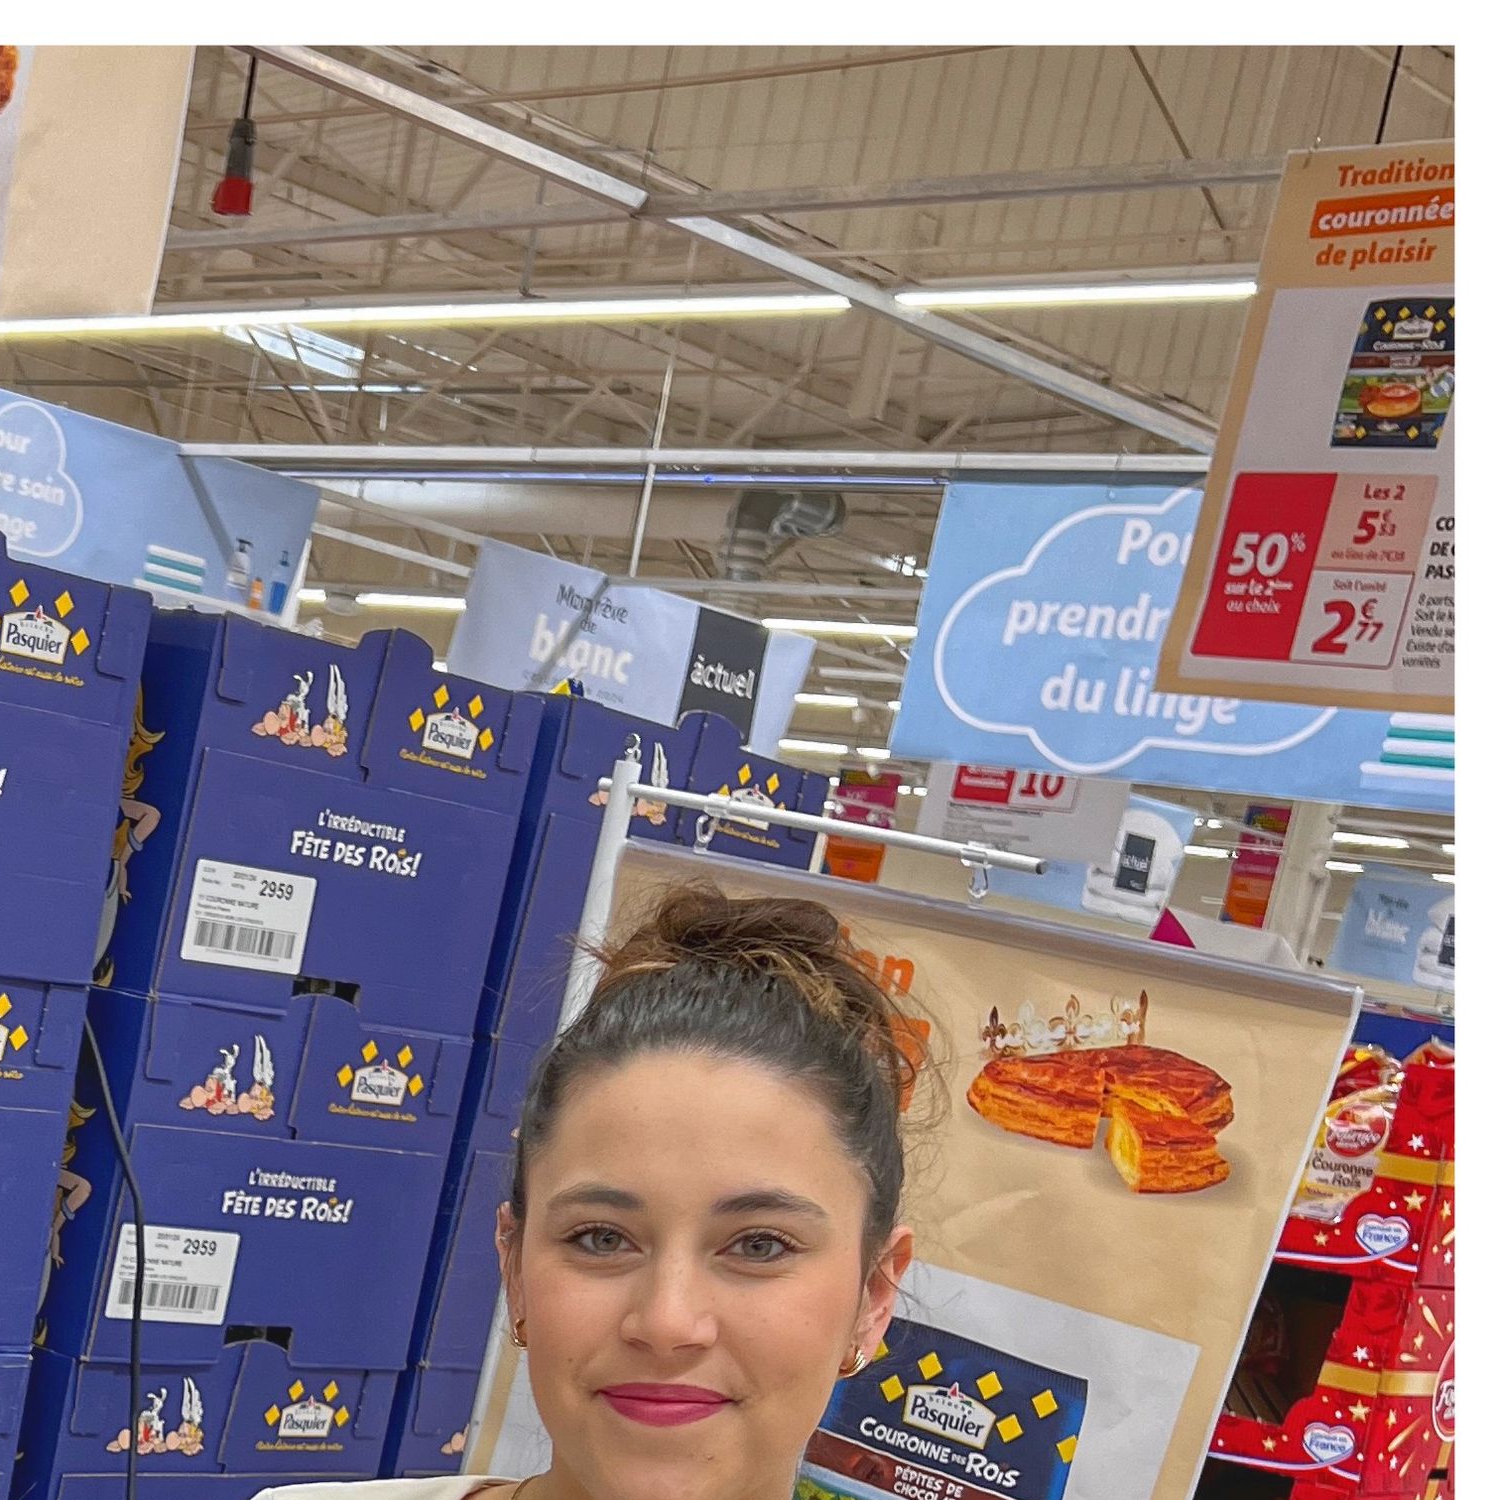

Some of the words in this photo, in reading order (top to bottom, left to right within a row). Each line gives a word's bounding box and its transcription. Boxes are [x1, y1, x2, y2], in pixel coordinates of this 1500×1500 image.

[1318, 196, 1454, 230] couronnée
[1316, 243, 1346, 266] de
[1349, 238, 1438, 272] plaisir
[18, 476, 66, 506] soin
[1364, 483, 1390, 500] Les
[1393, 485, 1406, 500] 2
[1430, 542, 1449, 556] DE
[1002, 593, 1171, 646] prendr
[6, 623, 62, 654] Pasquier
[530, 613, 634, 685] blanc
[1041, 662, 1107, 713] du
[1114, 666, 1239, 735] linge
[428, 722, 472, 752] Pasquier
[290, 830, 330, 860] FÊTE
[333, 842, 365, 867] DES
[259, 880, 294, 901] 2959
[356, 1076, 401, 1099] Pasquier
[1312, 1157, 1373, 1177] Couronne
[1332, 1172, 1361, 1189] Rois
[222, 1190, 262, 1216] FÊTE
[264, 1200, 297, 1219] DES
[183, 1239, 217, 1256] 2959
[283, 1414, 327, 1432] Pasquier
[911, 1395, 984, 1437] Pasquier
[860, 1417, 951, 1463] COURONNE
[1309, 1438, 1346, 1452] France
[895, 1465, 944, 1491] PÉPITES
[946, 1483, 964, 1498] DE
